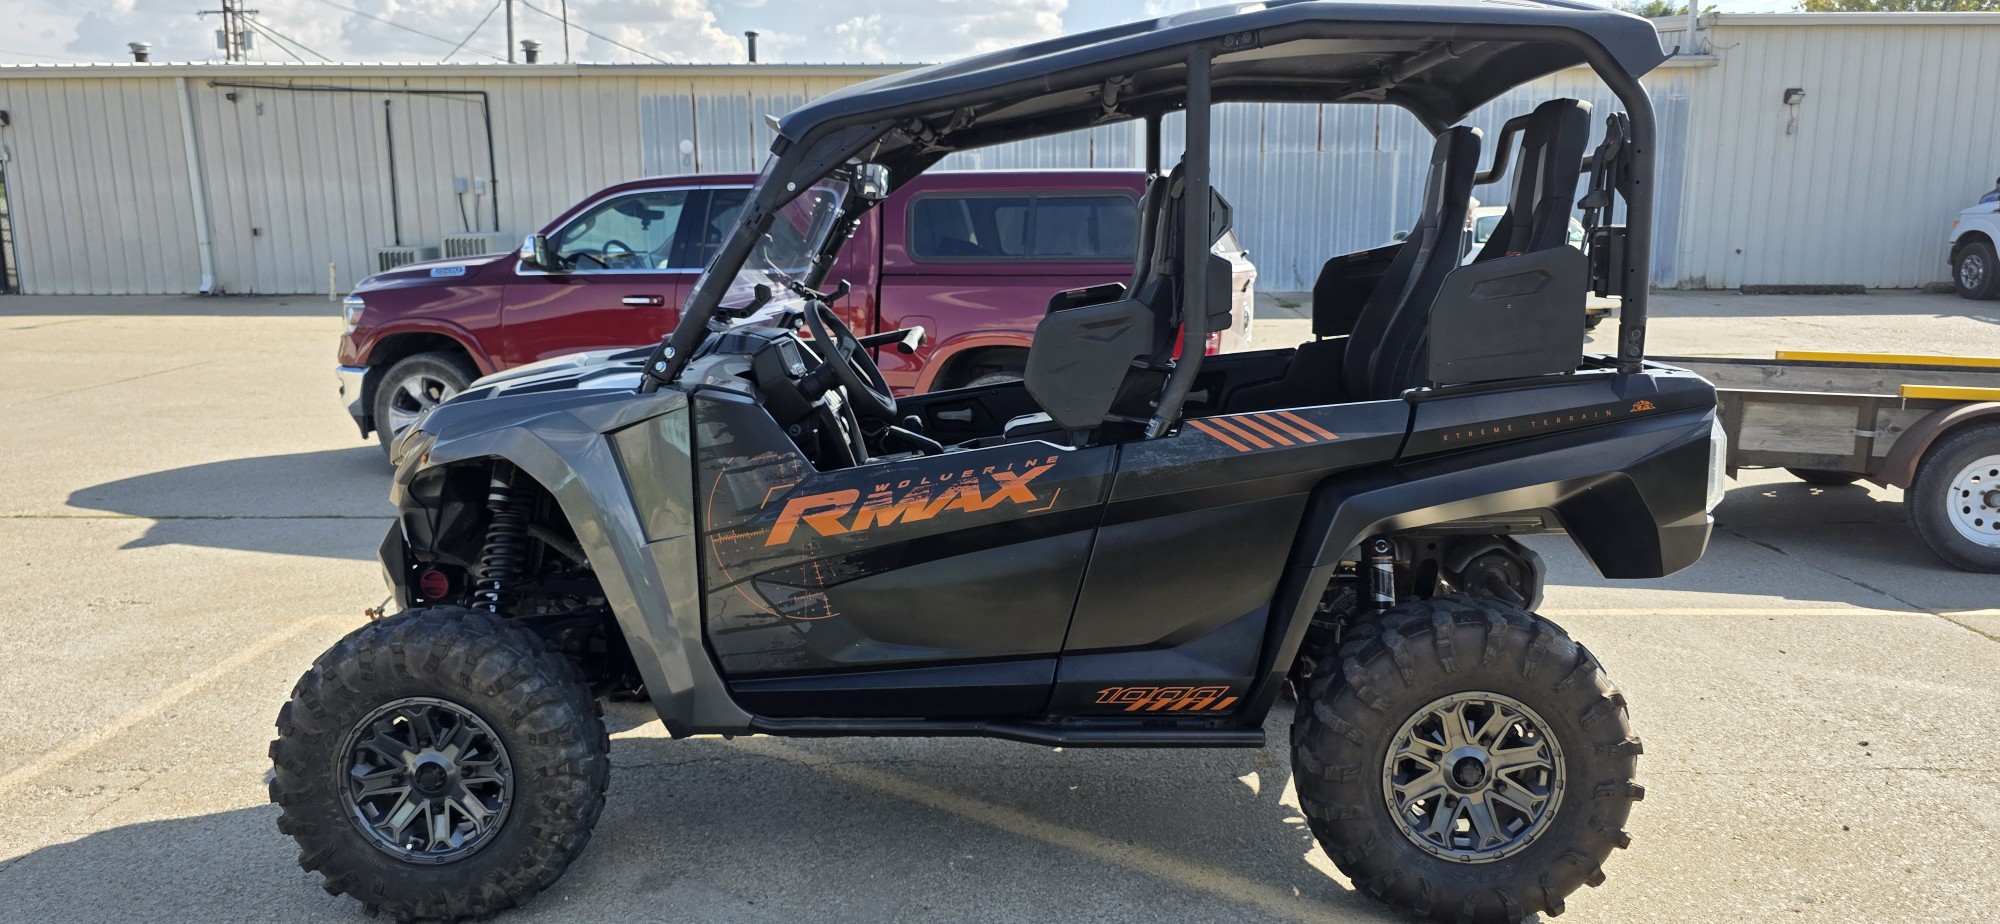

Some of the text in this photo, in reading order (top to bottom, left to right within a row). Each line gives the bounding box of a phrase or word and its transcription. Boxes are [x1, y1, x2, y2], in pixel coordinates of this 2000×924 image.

[1443, 410, 1612, 442] XTREME TERRAIN
[764, 463, 1057, 548] RMAX
[1095, 686, 1231, 704] 1000
